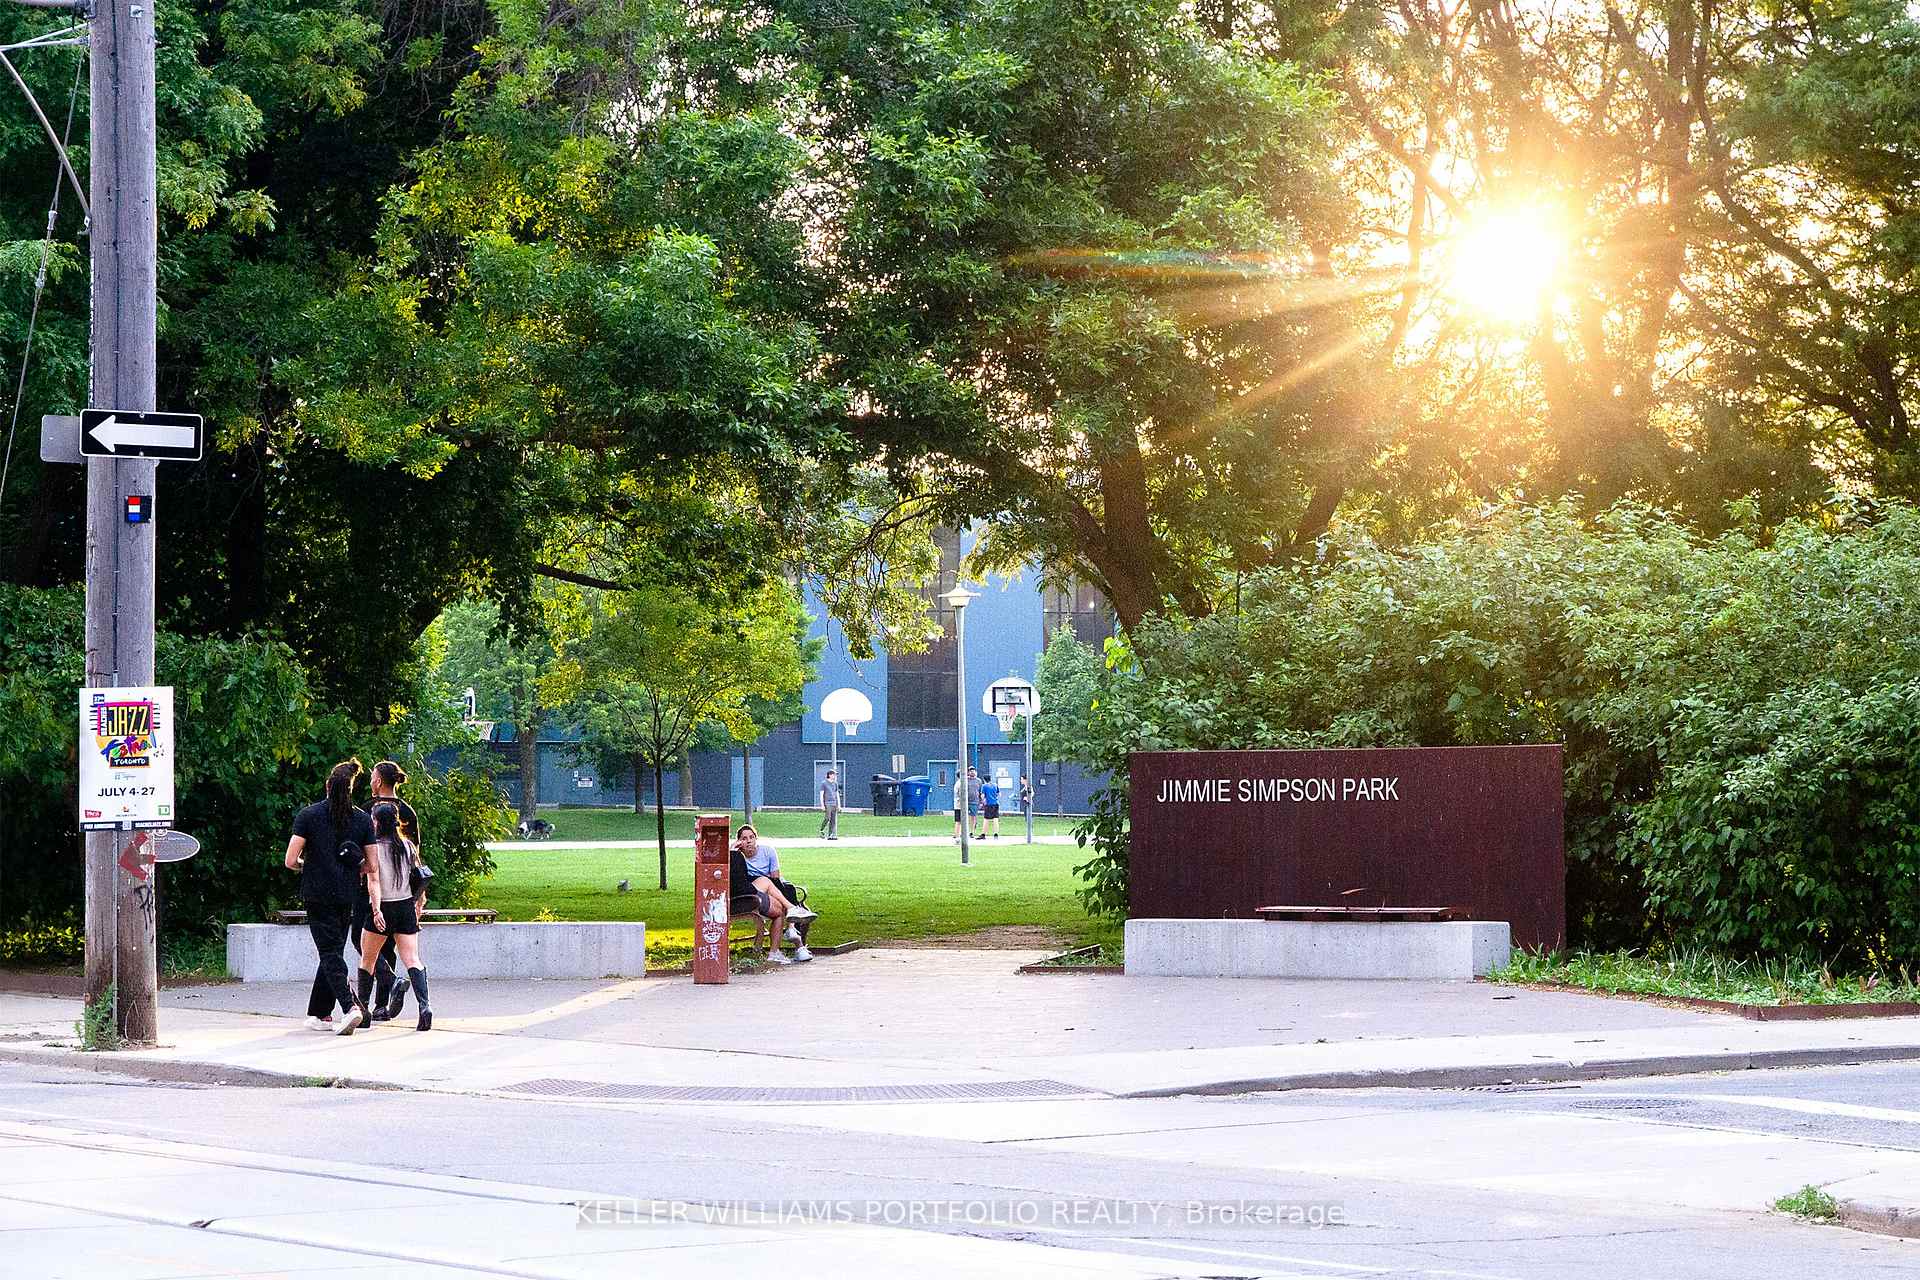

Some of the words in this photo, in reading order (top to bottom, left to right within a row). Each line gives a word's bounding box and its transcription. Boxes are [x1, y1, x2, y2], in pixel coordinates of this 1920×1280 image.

[108, 706, 148, 735] JAZZ
[97, 787, 127, 797] JULY
[1156, 778, 1231, 803] JIMMIE
[1237, 778, 1336, 802] SIMPSON
[1342, 777, 1400, 801] PARK
